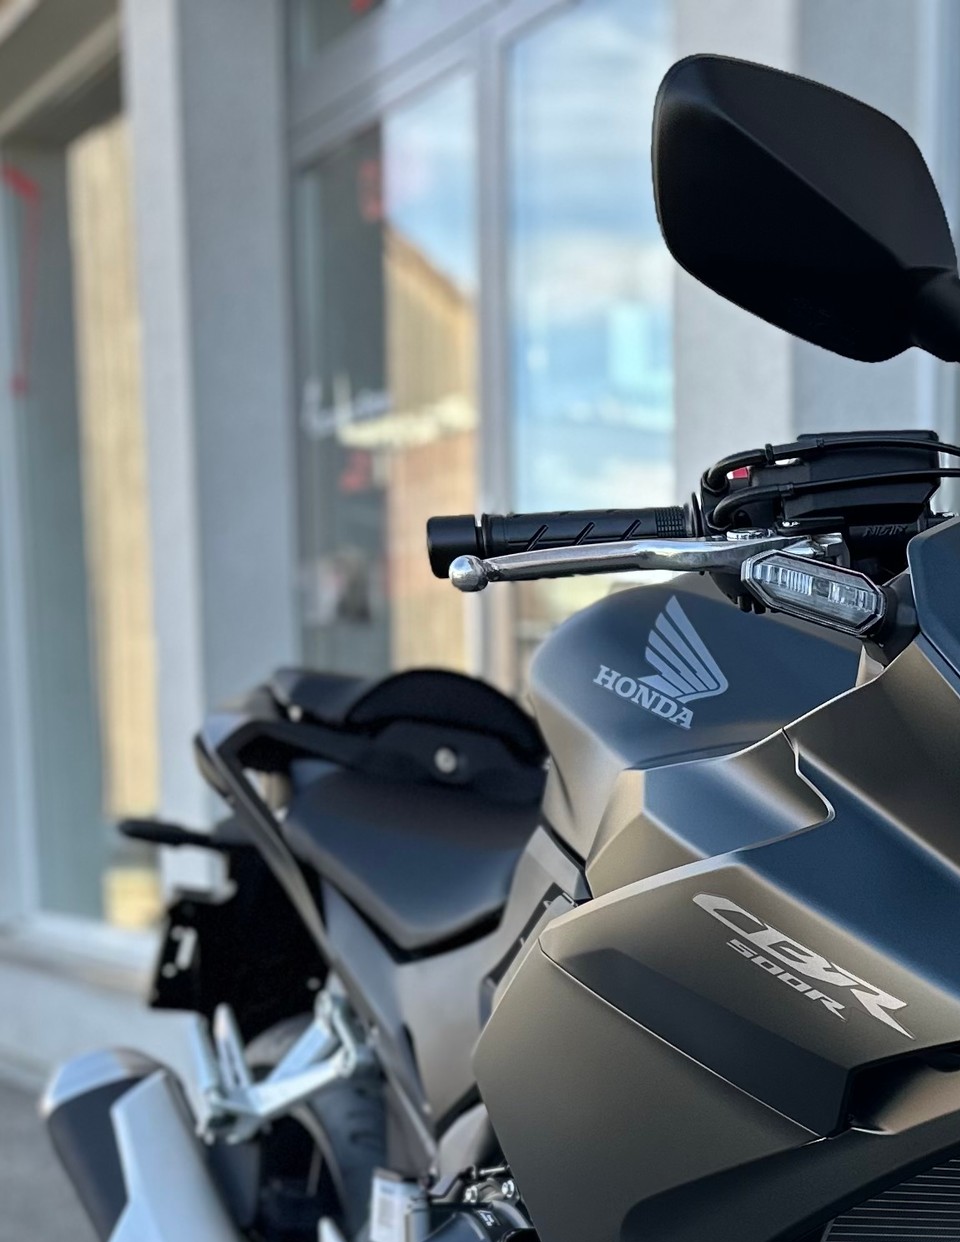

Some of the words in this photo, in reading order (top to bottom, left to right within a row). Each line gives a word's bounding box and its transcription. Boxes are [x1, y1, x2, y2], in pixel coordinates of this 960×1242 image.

[593, 664, 694, 731] HONDA
[692, 893, 916, 1041] CBR
[726, 938, 849, 1023] 500R
